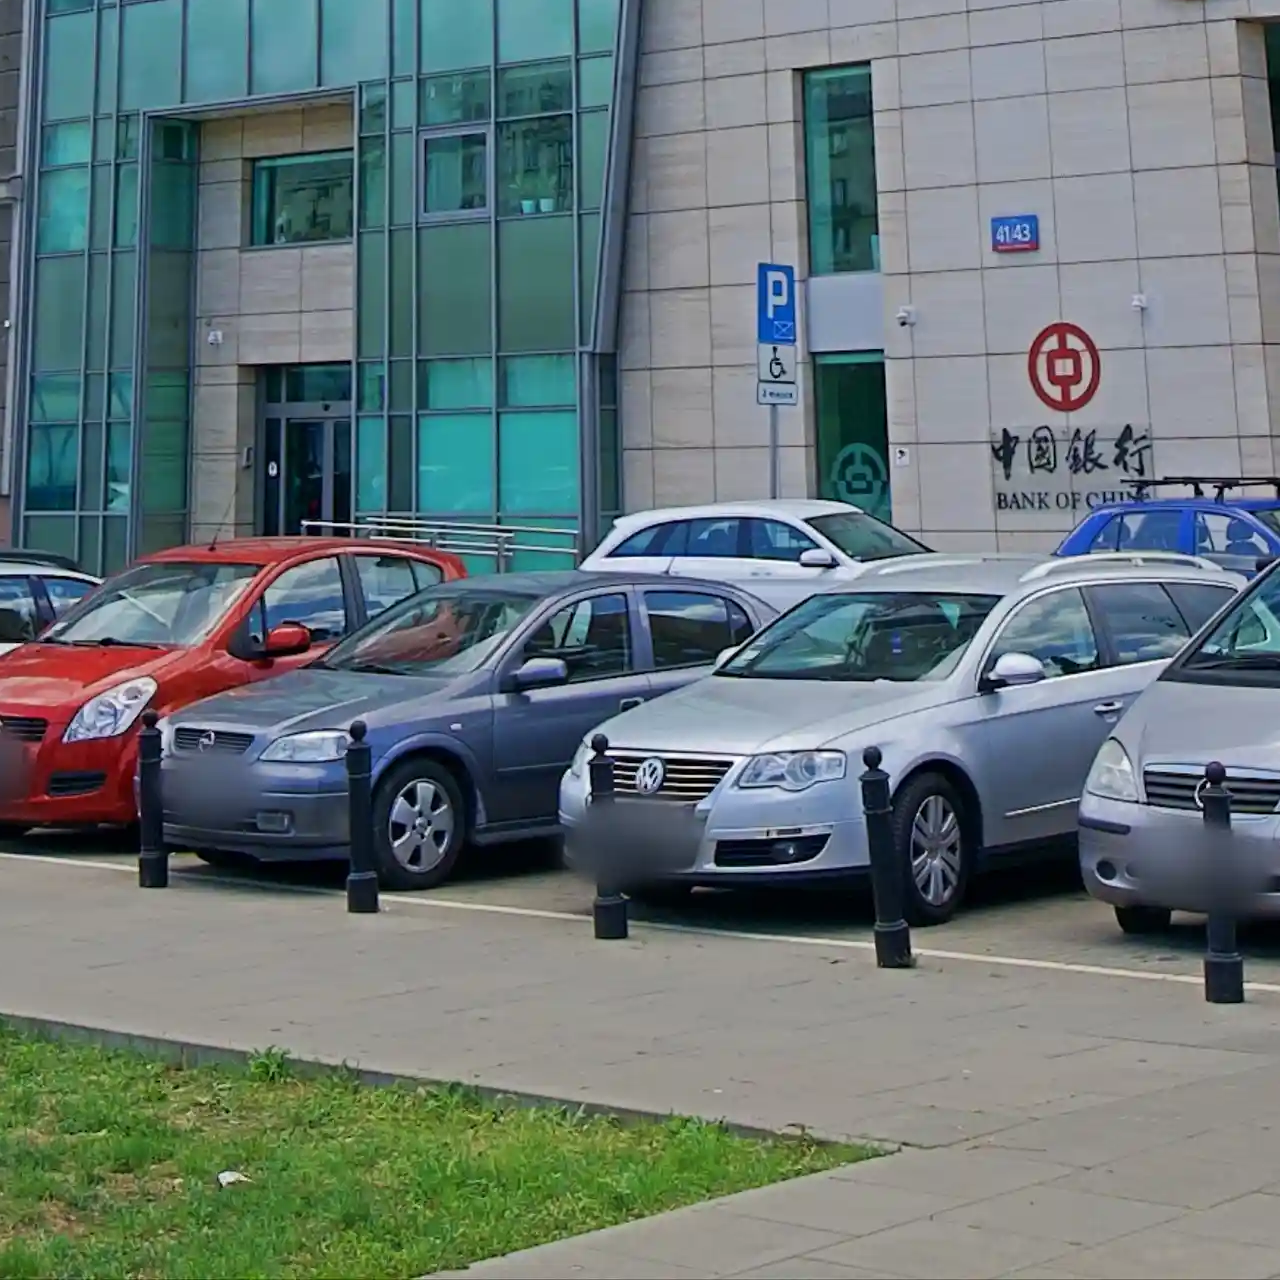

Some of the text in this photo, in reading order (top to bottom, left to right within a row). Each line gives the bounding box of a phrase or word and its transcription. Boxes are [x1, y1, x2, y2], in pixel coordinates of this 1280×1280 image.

[995, 223, 1032, 244] 41/43
[766, 270, 789, 320] P
[990, 423, 1153, 482] 中國銀行
[996, 492, 1052, 511] BANK
[1056, 492, 1082, 511] OF
